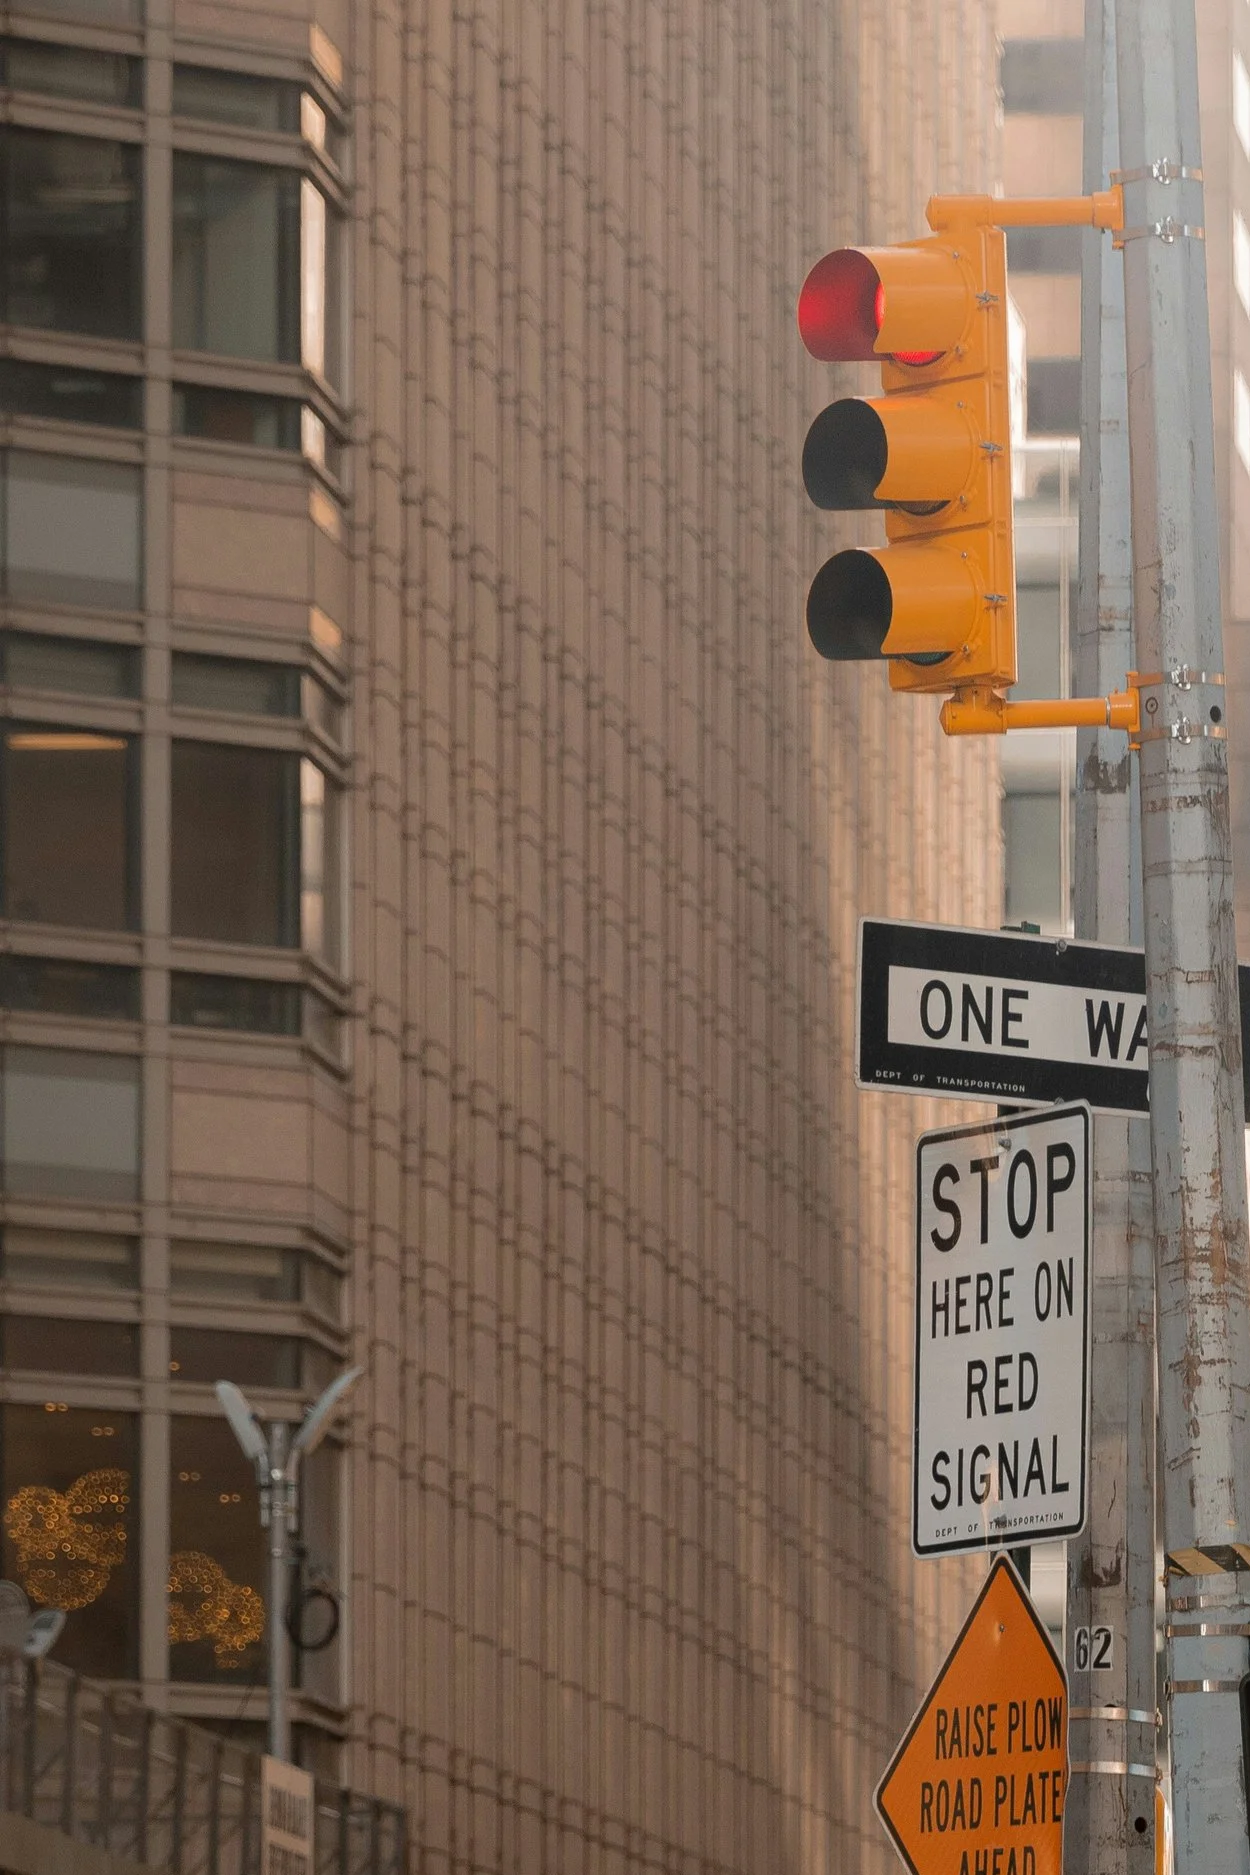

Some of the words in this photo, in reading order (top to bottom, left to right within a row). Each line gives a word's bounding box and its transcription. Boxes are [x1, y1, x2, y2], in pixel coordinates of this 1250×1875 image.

[919, 980, 1030, 1049] ONE
[1084, 998, 1149, 1062] WA
[876, 1070, 901, 1080] DEPT
[912, 1074, 926, 1082] OF
[936, 1076, 1026, 1093] TRANSPORTATION
[930, 1141, 1076, 1253] STOP
[930, 1267, 1015, 1339] HERE
[1034, 1256, 1075, 1322] ON
[965, 1351, 1039, 1419] RED
[930, 1434, 1070, 1511] SIGNAL
[935, 1526, 958, 1538] DEPT
[968, 1523, 979, 1533] OF
[1076, 1627, 1112, 1670] 62
[935, 1702, 998, 1760] RAISE
[1007, 1697, 1062, 1754] PLOW
[920, 1779, 982, 1834] ROAD
